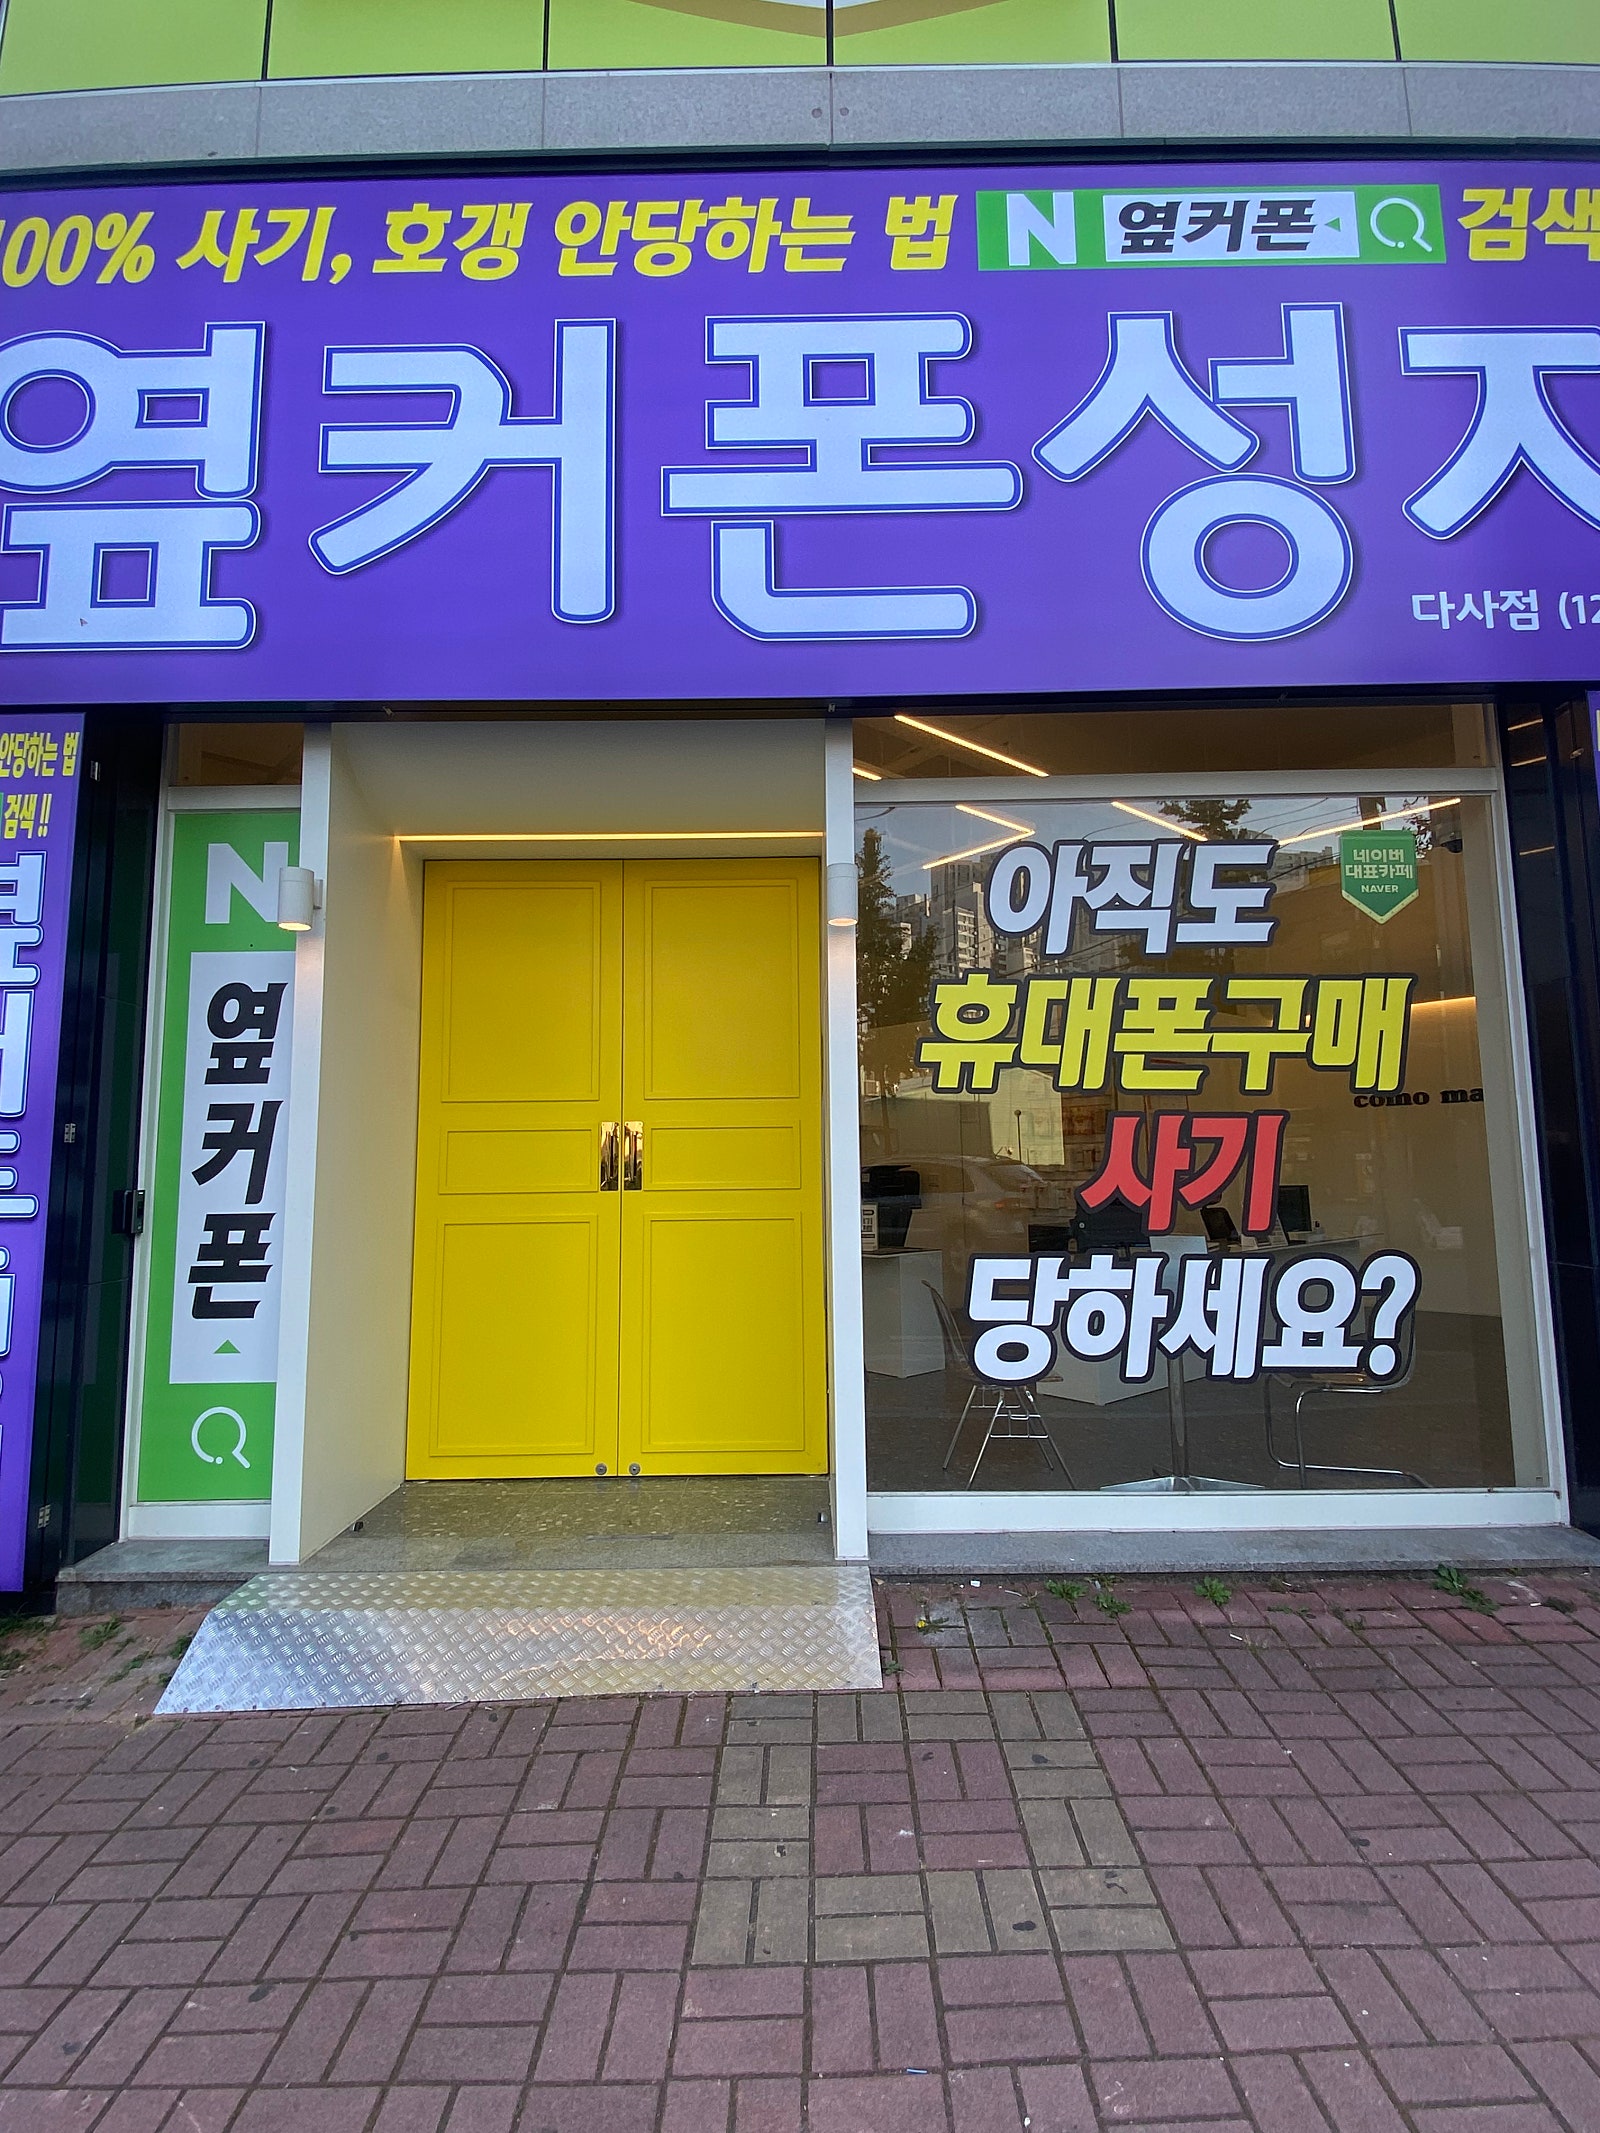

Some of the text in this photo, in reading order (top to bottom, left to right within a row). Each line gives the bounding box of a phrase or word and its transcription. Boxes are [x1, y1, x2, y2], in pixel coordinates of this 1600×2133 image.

[177, 207, 352, 285] 사기,
[373, 203, 532, 280] 호갱
[554, 197, 856, 277] 안당하는
[884, 194, 958, 270] 법
[1117, 199, 1318, 255] 옆커폰
[1457, 188, 1600, 262] 검색
[1411, 589, 1540, 631] 다사점
[0, 732, 80, 778] 안당하는 법
[4, 794, 38, 839] 검색
[1345, 864, 1414, 879] 대표카페
[1353, 848, 1405, 863] 네이버
[989, 841, 1277, 955] 아직도
[1361, 884, 1399, 893] NAVER
[919, 973, 1412, 1091] 휴대폰구매
[1353, 1092, 1430, 1108] como
[187, 981, 289, 1320] 옆커폰
[1079, 1114, 1289, 1232] 사기
[968, 1254, 1416, 1380] 당하세요?
